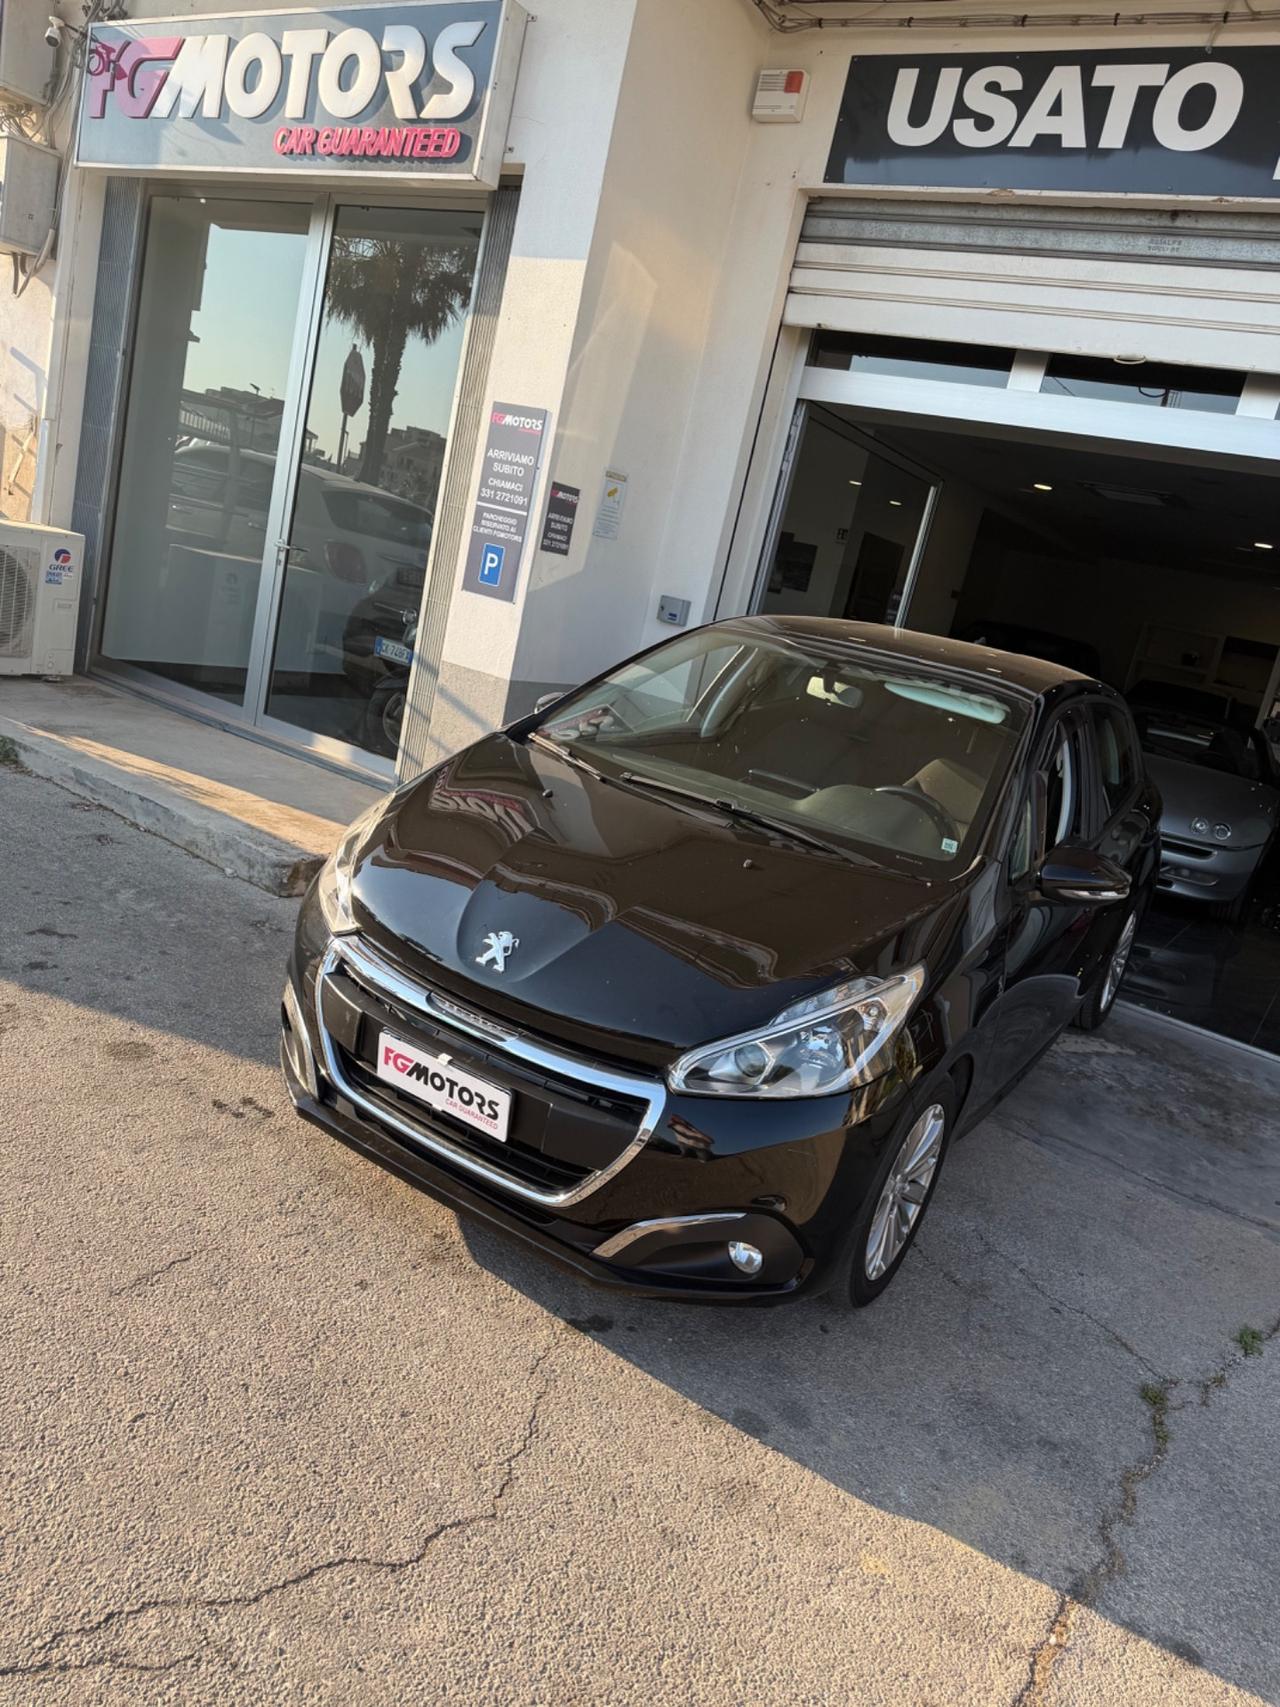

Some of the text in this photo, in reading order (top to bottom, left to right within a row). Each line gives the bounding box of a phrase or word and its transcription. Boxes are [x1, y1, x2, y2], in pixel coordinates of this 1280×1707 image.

[88, 20, 486, 120] FGMOTORS
[887, 61, 1244, 152] USATO
[273, 127, 461, 158] CAR GUARANTEED
[487, 448, 535, 466] ARRIVIAMO
[492, 462, 525, 477] SUBITO
[487, 477, 524, 492] CHIAMACI
[480, 487, 528, 506] 331 2721091
[49, 563, 74, 572] GREE
[484, 552, 499, 575] P
[384, 1046, 500, 1121] FGMOTORS
[445, 1098, 498, 1130] CAR GUARANTEED
